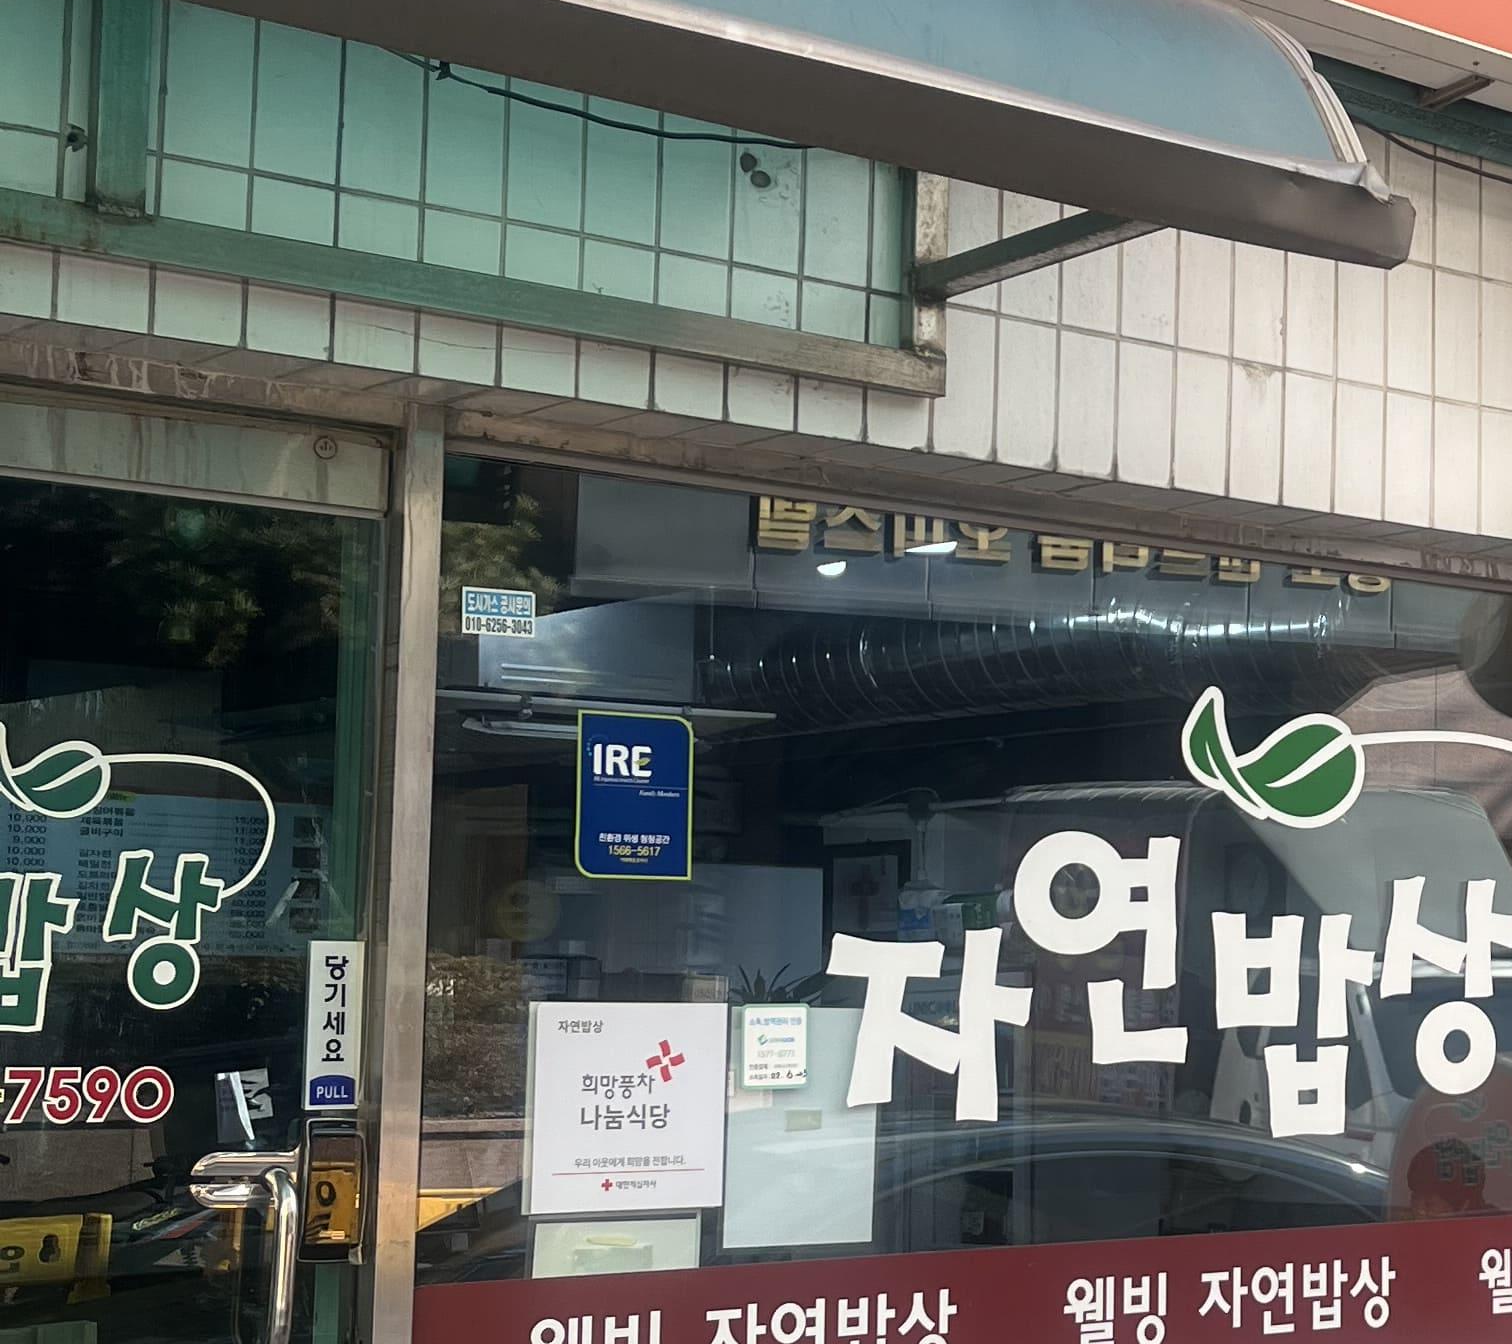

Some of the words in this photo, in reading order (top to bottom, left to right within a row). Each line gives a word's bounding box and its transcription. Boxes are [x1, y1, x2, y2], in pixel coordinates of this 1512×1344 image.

[467, 593, 499, 613] 도시가스
[465, 616, 533, 635] 010-6256-3043
[592, 742, 652, 778] IRE
[323, 954, 349, 1063] 당기세요
[558, 1019, 604, 1034] 자연밥상
[315, 1087, 348, 1099] PULL
[581, 1073, 655, 1099] 희망풍차
[580, 1103, 671, 1131] 나눔식당
[574, 1157, 591, 1168] 우리
[592, 1156, 625, 1168] 이웃에게
[1198, 1256, 1397, 1336] 자연밥상
